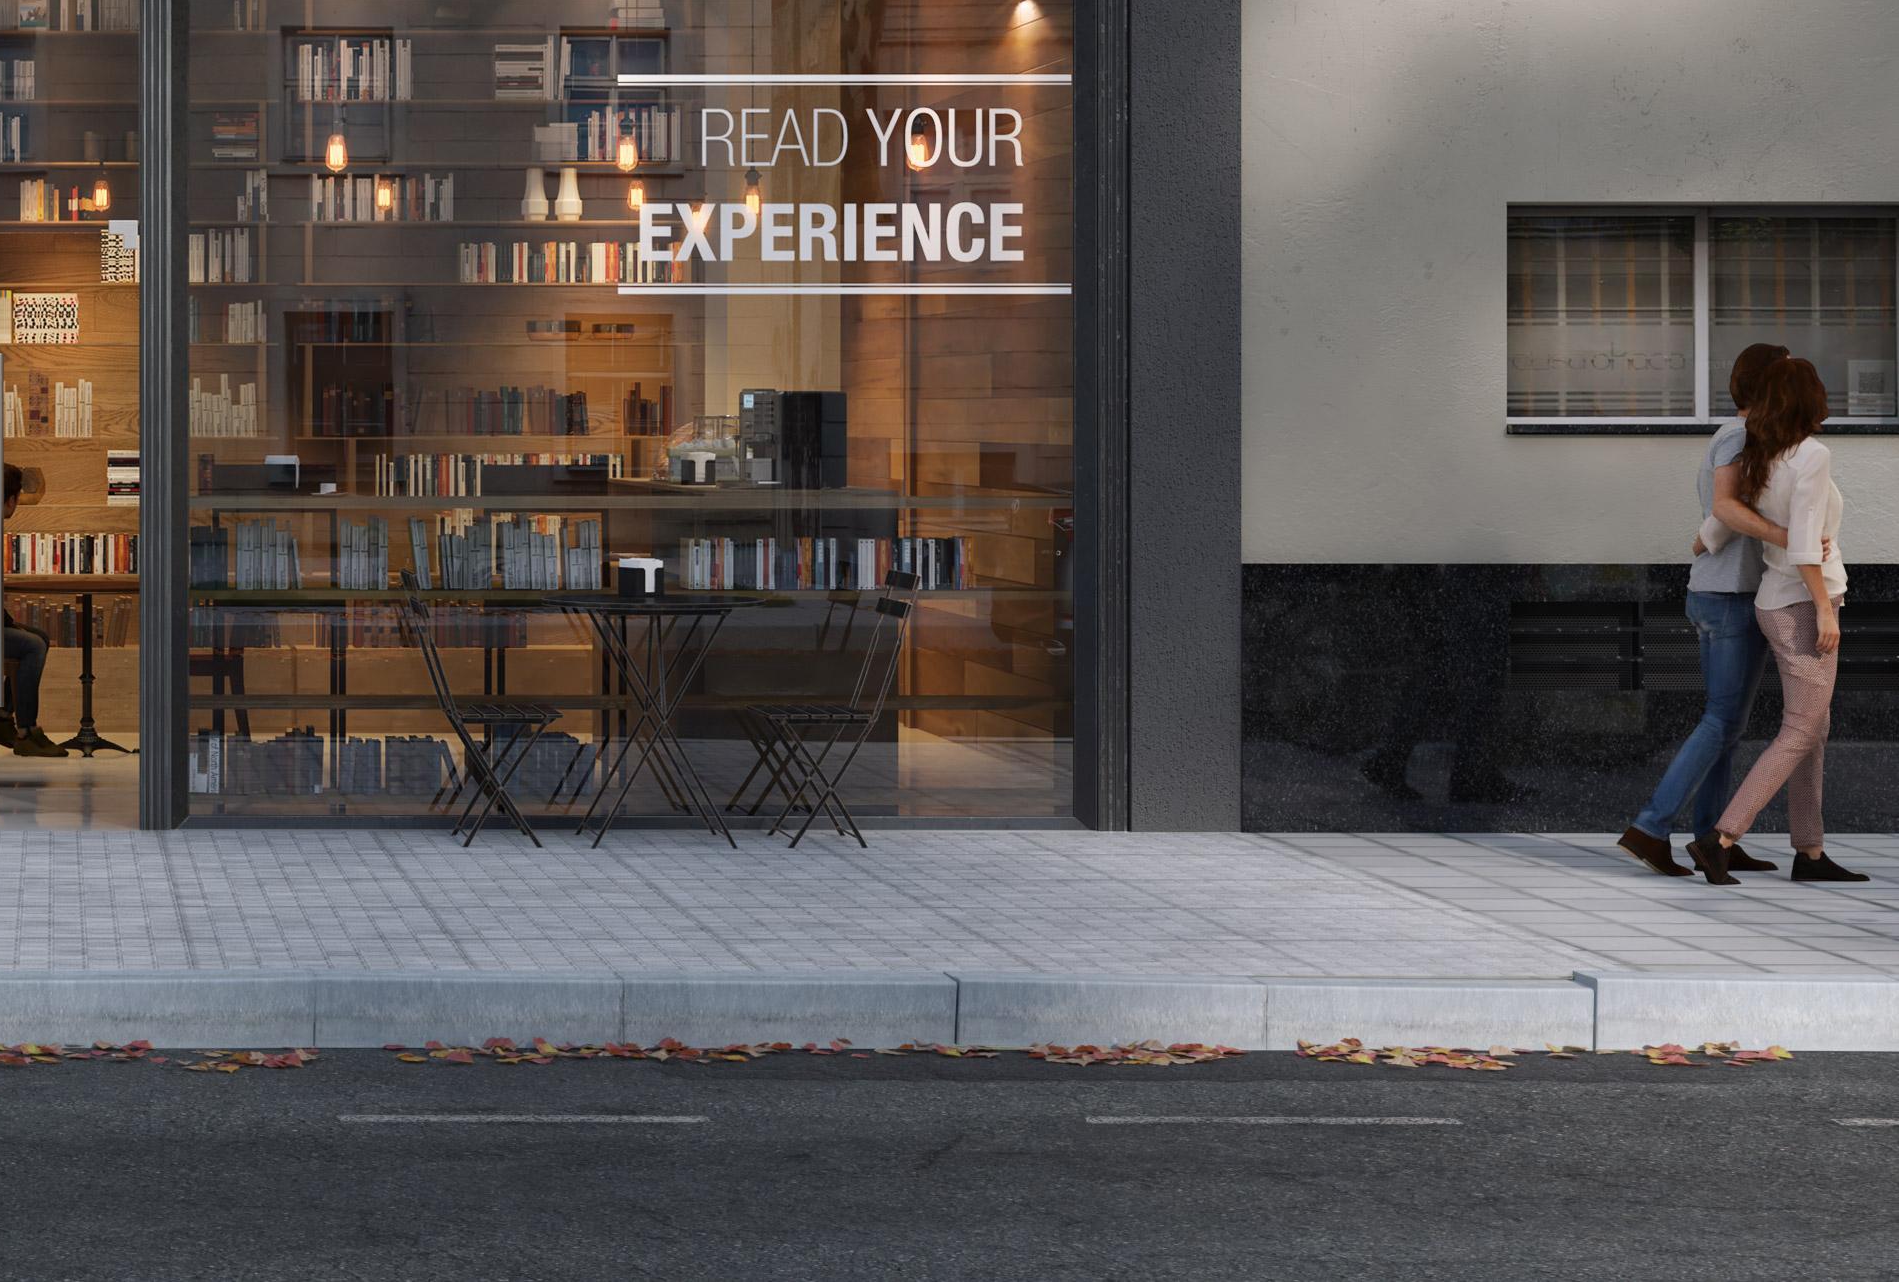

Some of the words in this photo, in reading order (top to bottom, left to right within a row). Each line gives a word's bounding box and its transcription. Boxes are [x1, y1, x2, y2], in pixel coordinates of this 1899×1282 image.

[701, 108, 849, 167] READ
[865, 106, 1025, 168] YOUR
[639, 202, 1025, 263] EXPERIENCE
